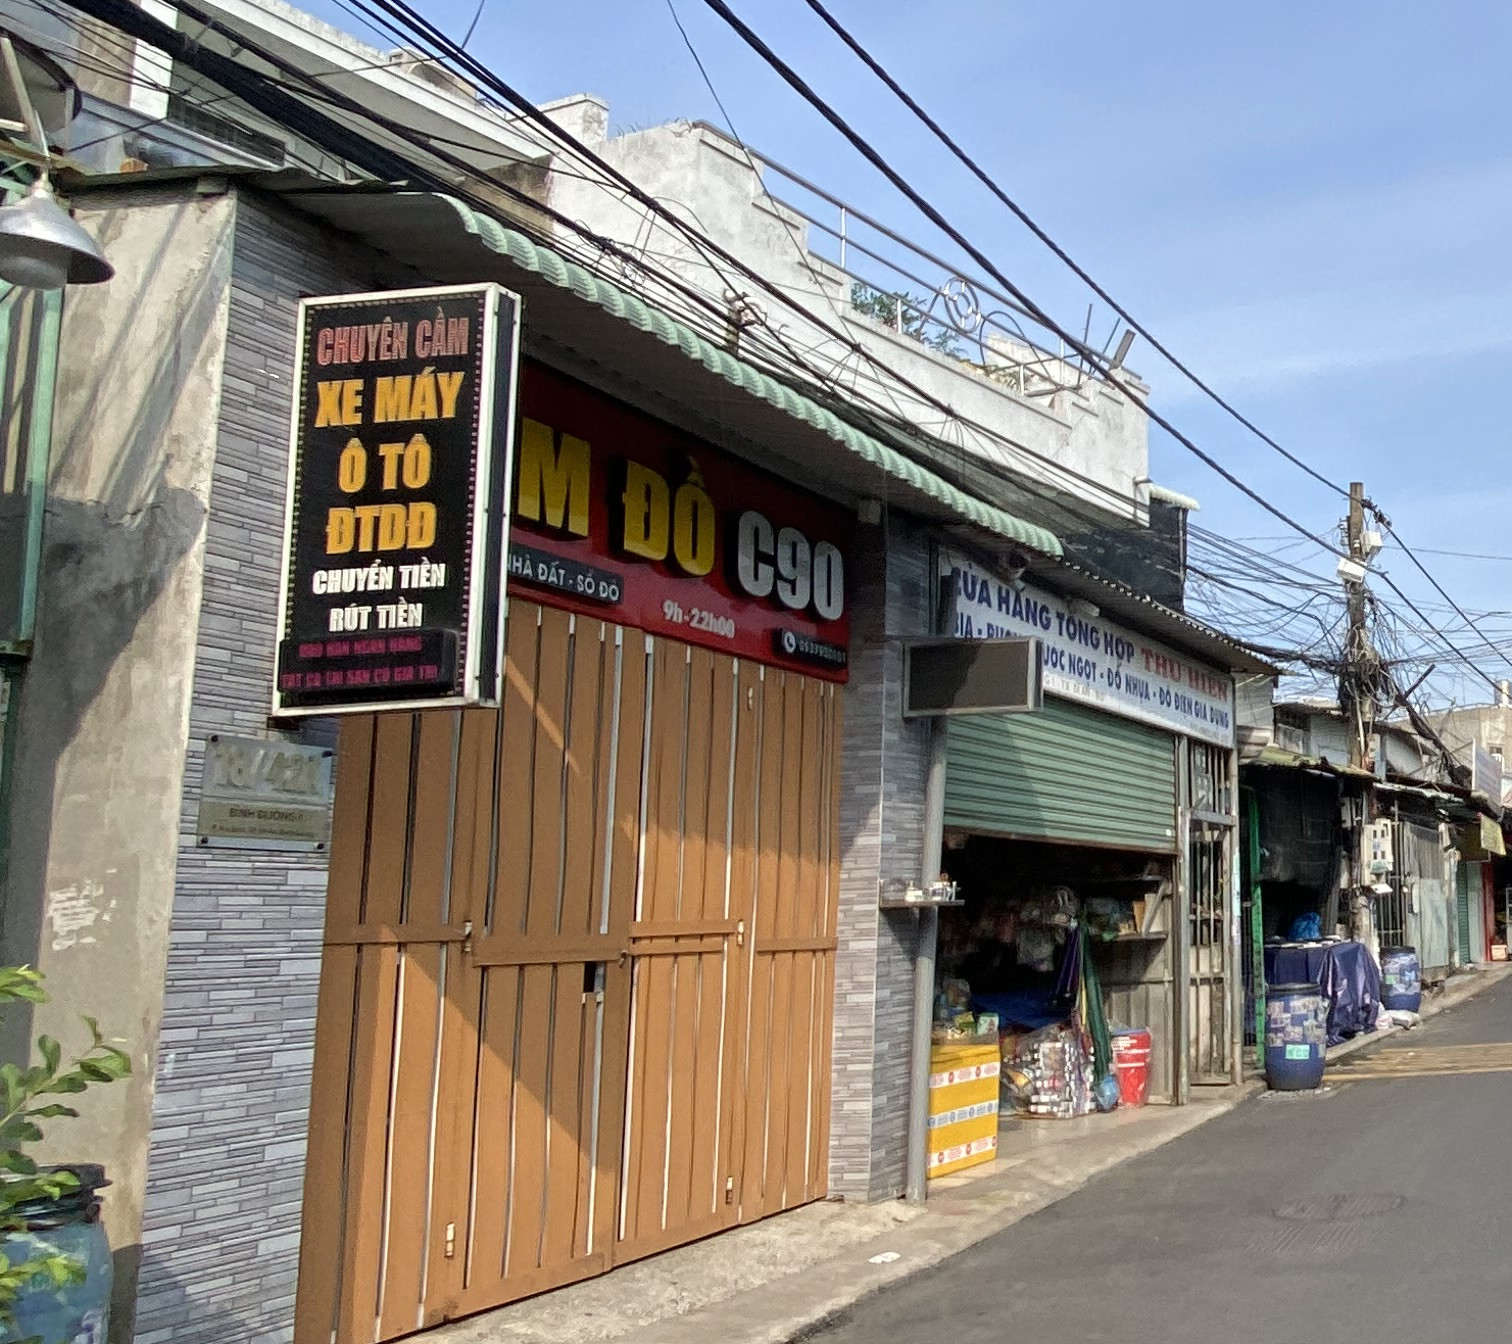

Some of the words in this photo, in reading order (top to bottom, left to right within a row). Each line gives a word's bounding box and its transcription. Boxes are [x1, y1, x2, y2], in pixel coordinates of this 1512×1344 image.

[317, 316, 407, 366] CHUYÊN
[415, 306, 469, 358] CẦM
[314, 379, 363, 428] XE
[374, 366, 465, 424] MÁY
[337, 437, 368, 494] Ô
[379, 433, 432, 490] TÔ
[622, 456, 716, 576] ĐỒ
[738, 510, 844, 621] C90
[399, 556, 446, 589] TIỀN
[538, 560, 566, 586] ĐẤT
[329, 602, 368, 633] RÚT
[377, 596, 423, 630] TIỀN
